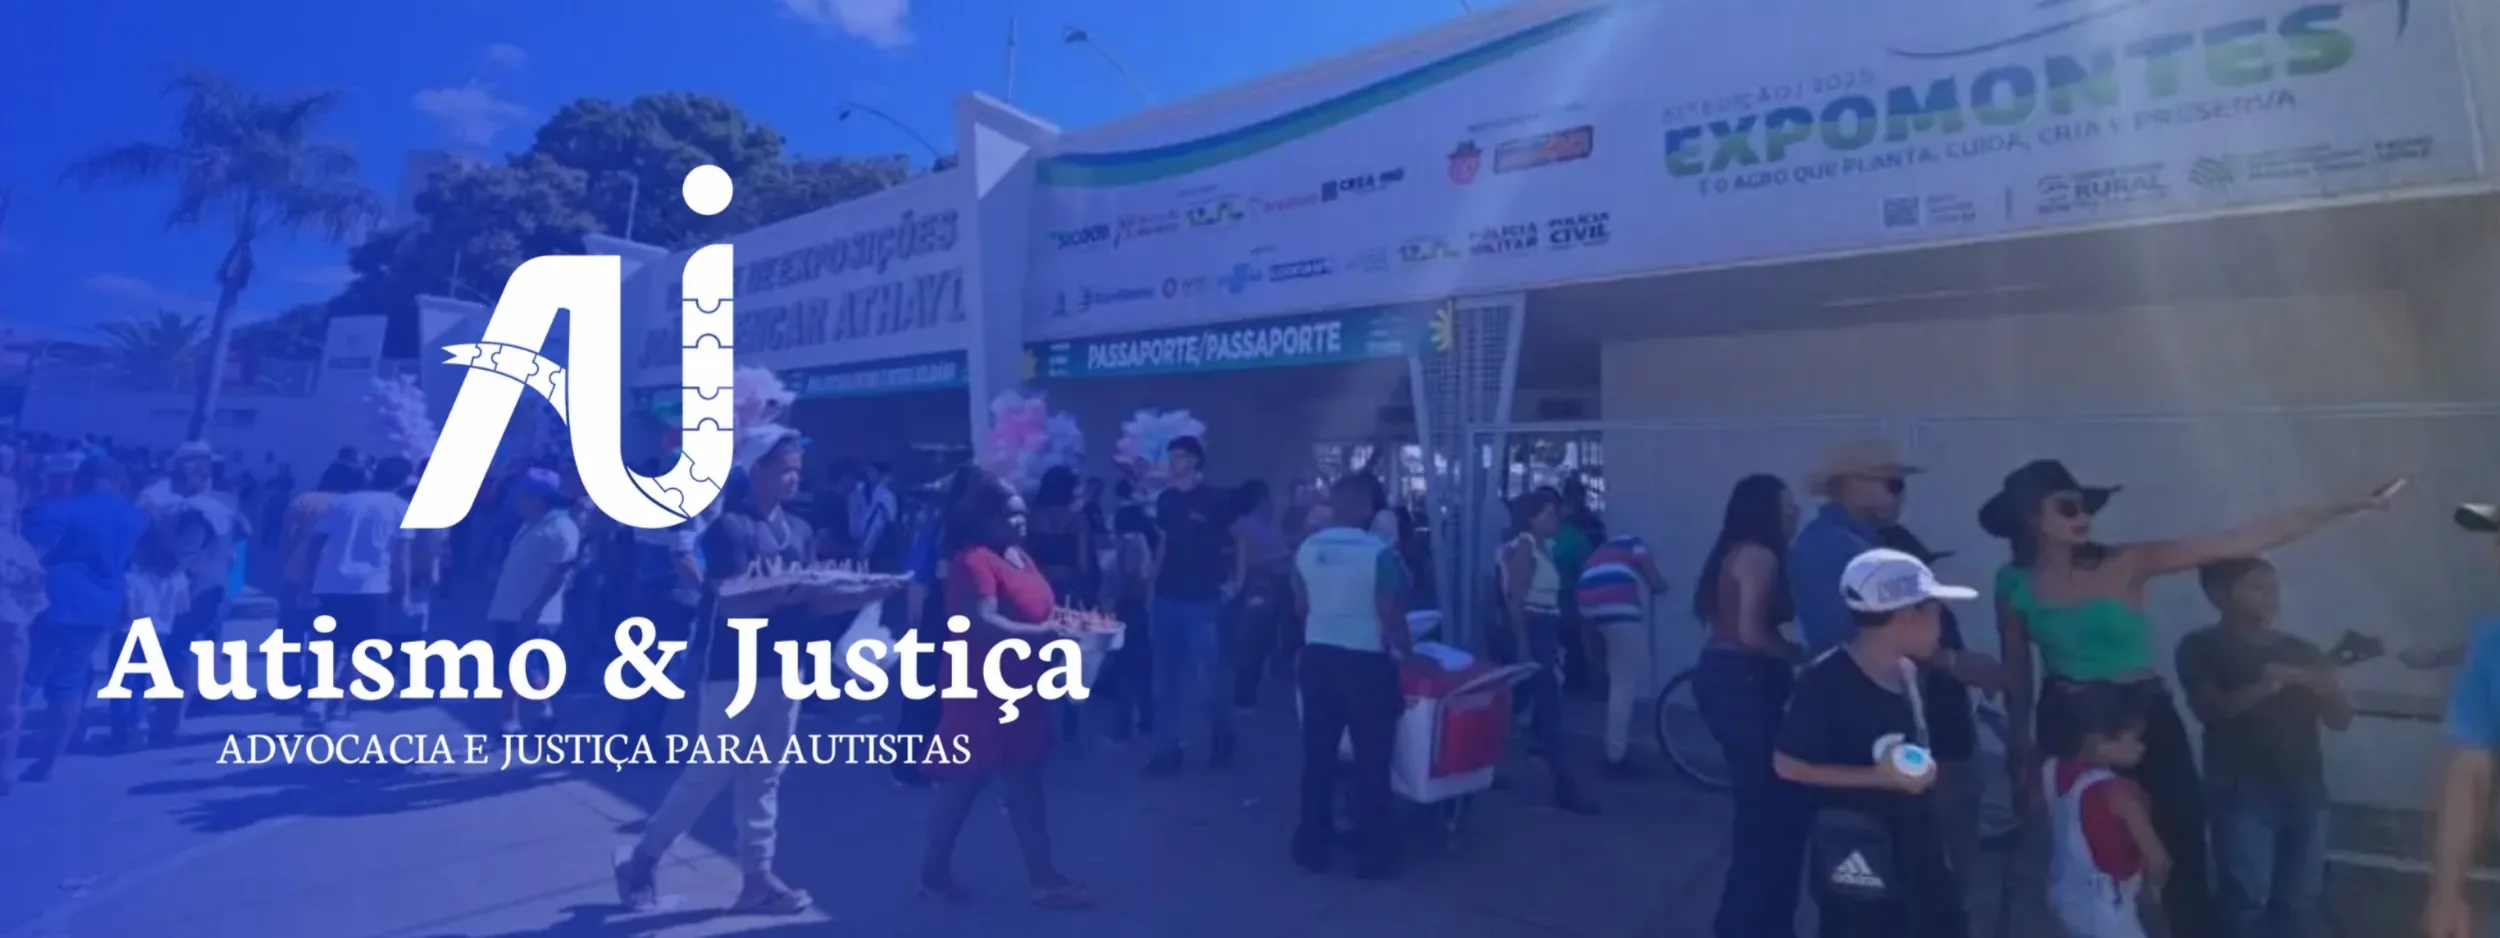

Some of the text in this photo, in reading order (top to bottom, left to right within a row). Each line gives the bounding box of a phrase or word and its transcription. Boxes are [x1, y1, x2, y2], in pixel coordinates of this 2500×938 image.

[1662, 2, 2356, 178] EXPOMONTES
[1733, 168, 1789, 190] AGRO
[1792, 162, 1838, 184] QUE
[1946, 132, 2032, 161] CUIDA,
[2038, 119, 2101, 146] CRIA
[2108, 114, 2126, 134] E
[2133, 88, 2298, 132] PRESERVA
[2074, 172, 2168, 200] RURAL
[776, 208, 959, 289] EXPOSIÇÕES
[1470, 235, 1539, 256] MILITAR
[1550, 222, 1612, 245] CIVIL
[1086, 321, 1342, 370] PASSAPORTE/PASSAPORTE
